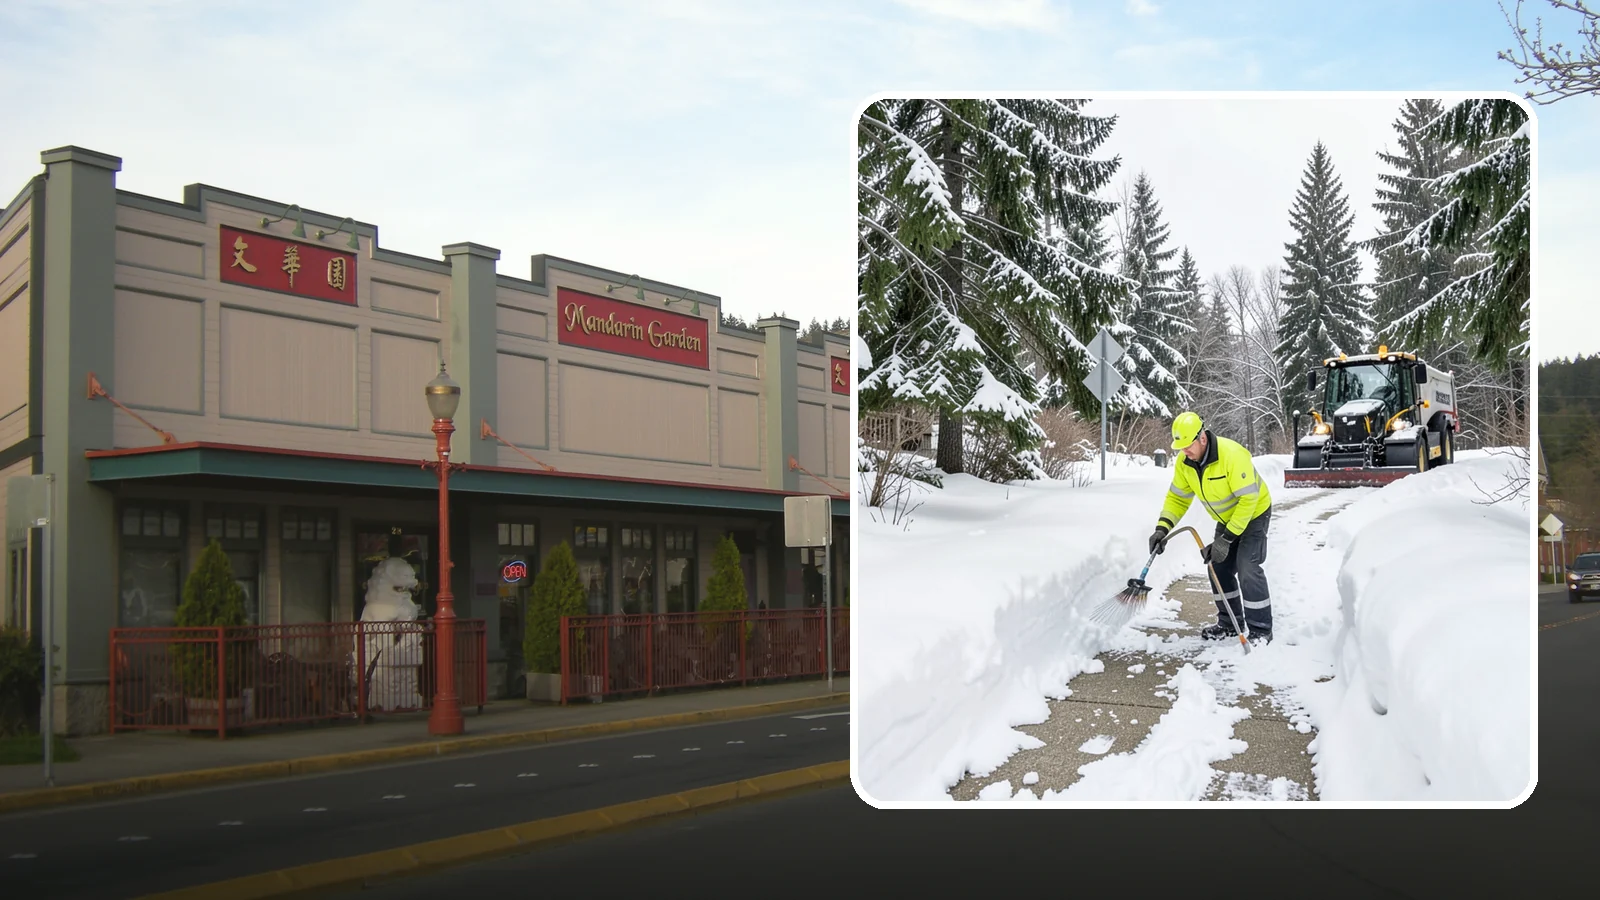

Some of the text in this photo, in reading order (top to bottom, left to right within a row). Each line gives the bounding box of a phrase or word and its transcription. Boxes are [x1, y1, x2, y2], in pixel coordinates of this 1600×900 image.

[230, 235, 346, 291] 文華園
[564, 302, 701, 352] Mandarin Garden
[503, 565, 527, 578] OPEN
